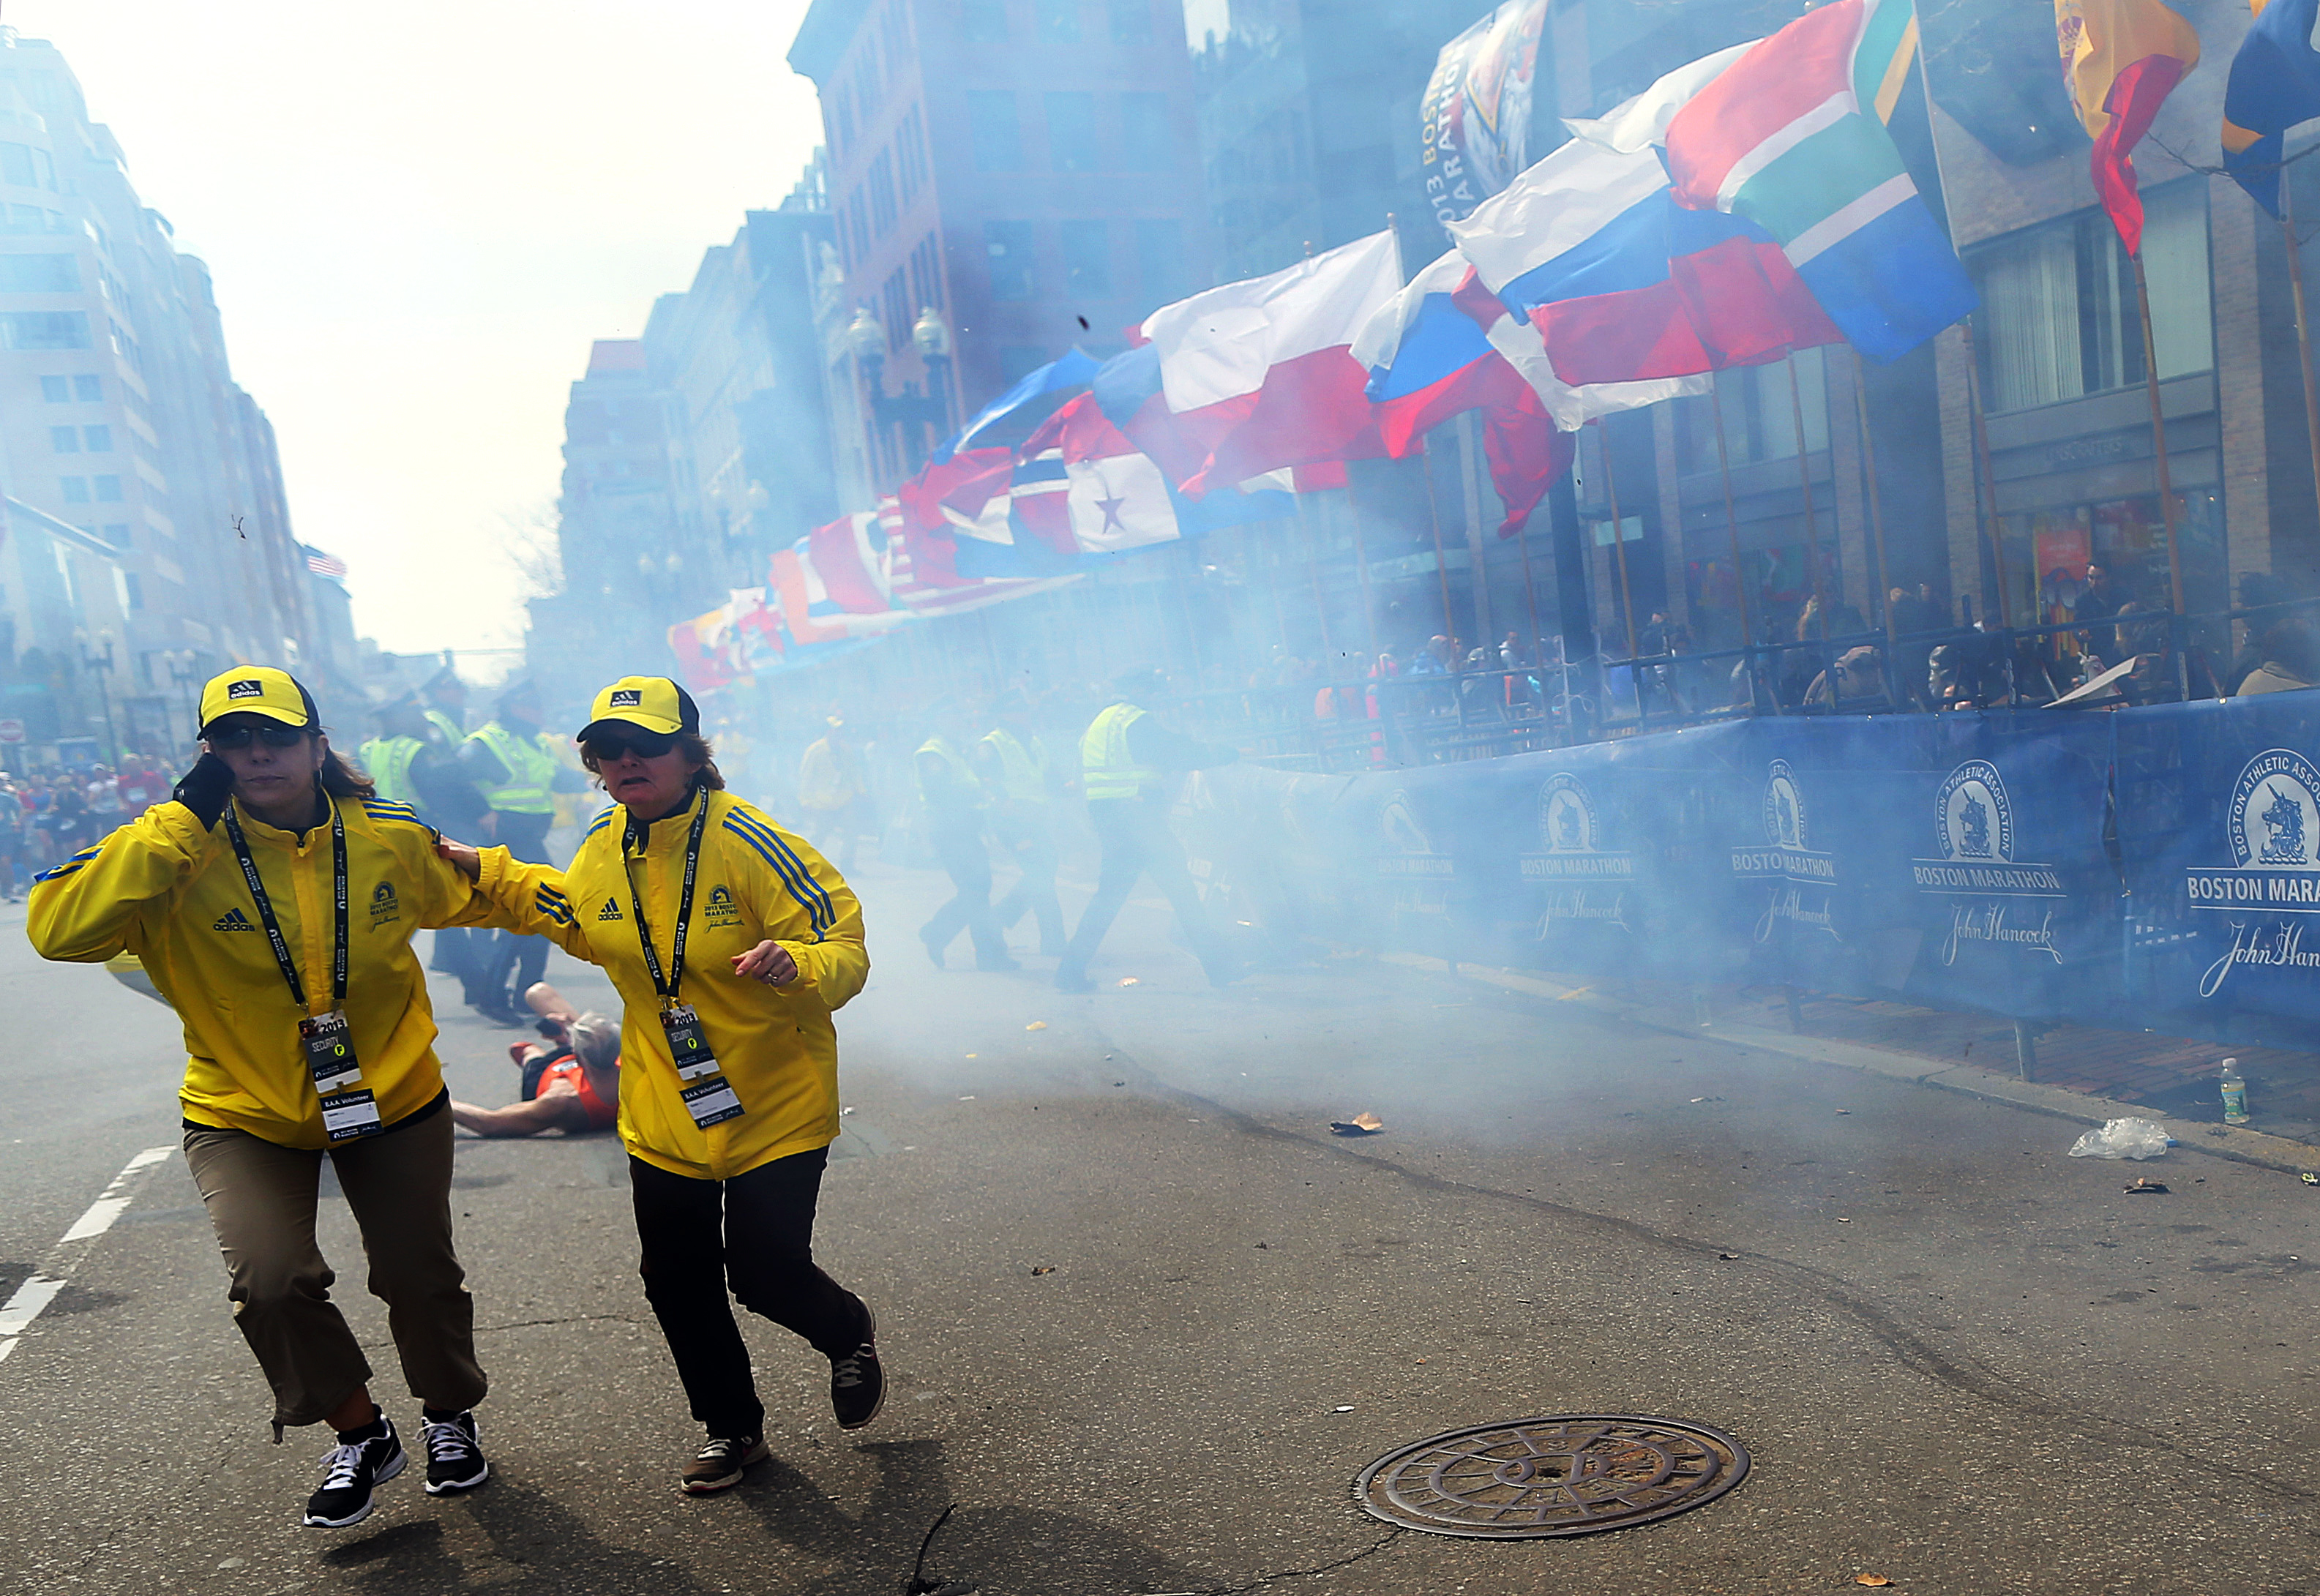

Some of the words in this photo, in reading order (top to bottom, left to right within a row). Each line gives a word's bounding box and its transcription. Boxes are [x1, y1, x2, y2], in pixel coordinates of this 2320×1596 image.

[231, 690, 261, 698] adidas
[1945, 766, 1984, 796] ATHLETIC
[1983, 771, 2010, 853] ASSOCIATION
[2233, 793, 2247, 856] BOSTON
[2242, 757, 2290, 793] ATHLETIC
[1520, 858, 1563, 874] BOSTON
[1564, 858, 1631, 874] MARATHON
[1732, 853, 1783, 871] BOSTO
[1914, 866, 1969, 887] BOSTON
[1970, 869, 2062, 889] MARATHON
[2187, 877, 2263, 901] BOSTON
[598, 913, 624, 921] adidas
[705, 909, 738, 917] MARATHO
[213, 923, 255, 932] adidas
[1942, 902, 1983, 966] John
[1983, 902, 2063, 965] Hancock
[2200, 920, 2271, 998] John
[321, 1019, 345, 1034] 2013
[676, 1013, 696, 1026] 2013
[312, 1035, 339, 1052] SECURITY
[337, 1046, 343, 1054] F
